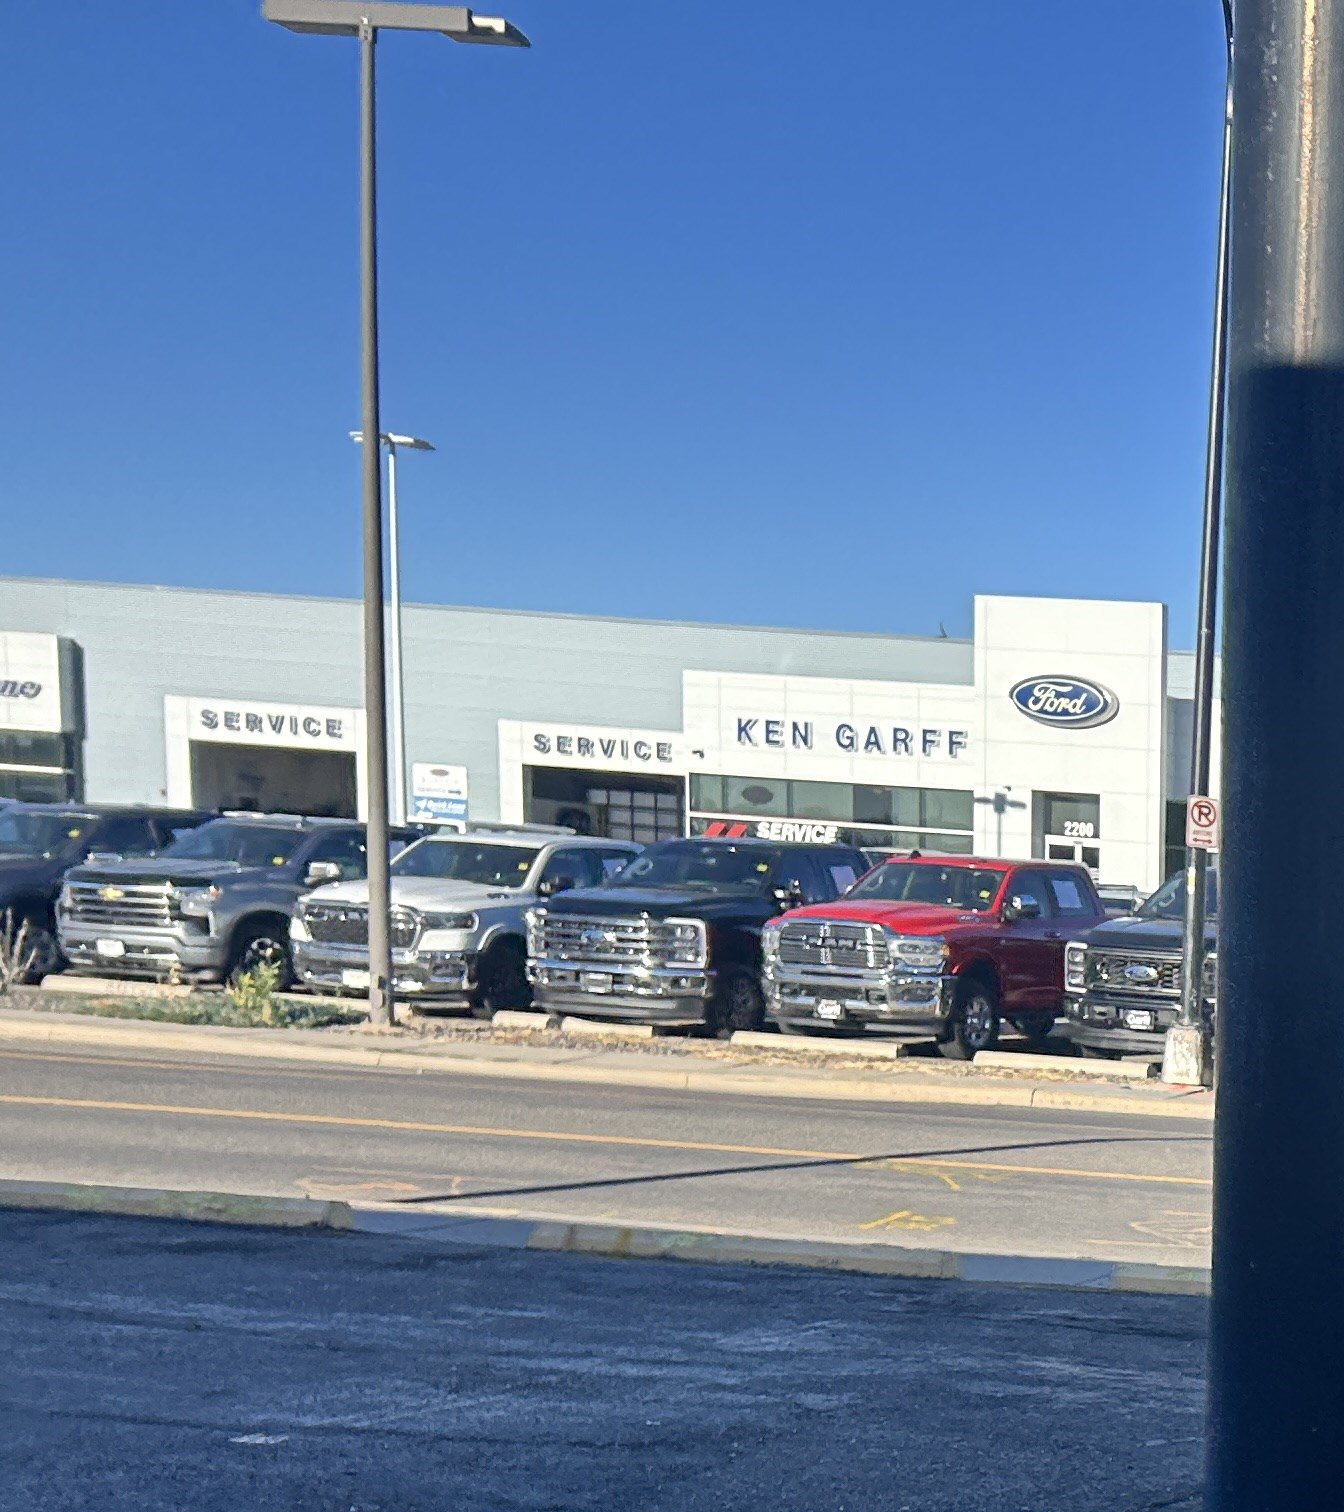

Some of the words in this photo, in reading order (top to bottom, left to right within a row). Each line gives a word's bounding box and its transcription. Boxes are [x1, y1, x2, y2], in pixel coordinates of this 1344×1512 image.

[1028, 683, 1087, 714] Ford
[201, 709, 342, 738] SERVICE
[737, 718, 812, 749] KEN
[836, 723, 967, 757] GARFF
[534, 734, 672, 762] SERVICE
[756, 821, 838, 843] SERVICE
[1064, 821, 1094, 837] 2200
